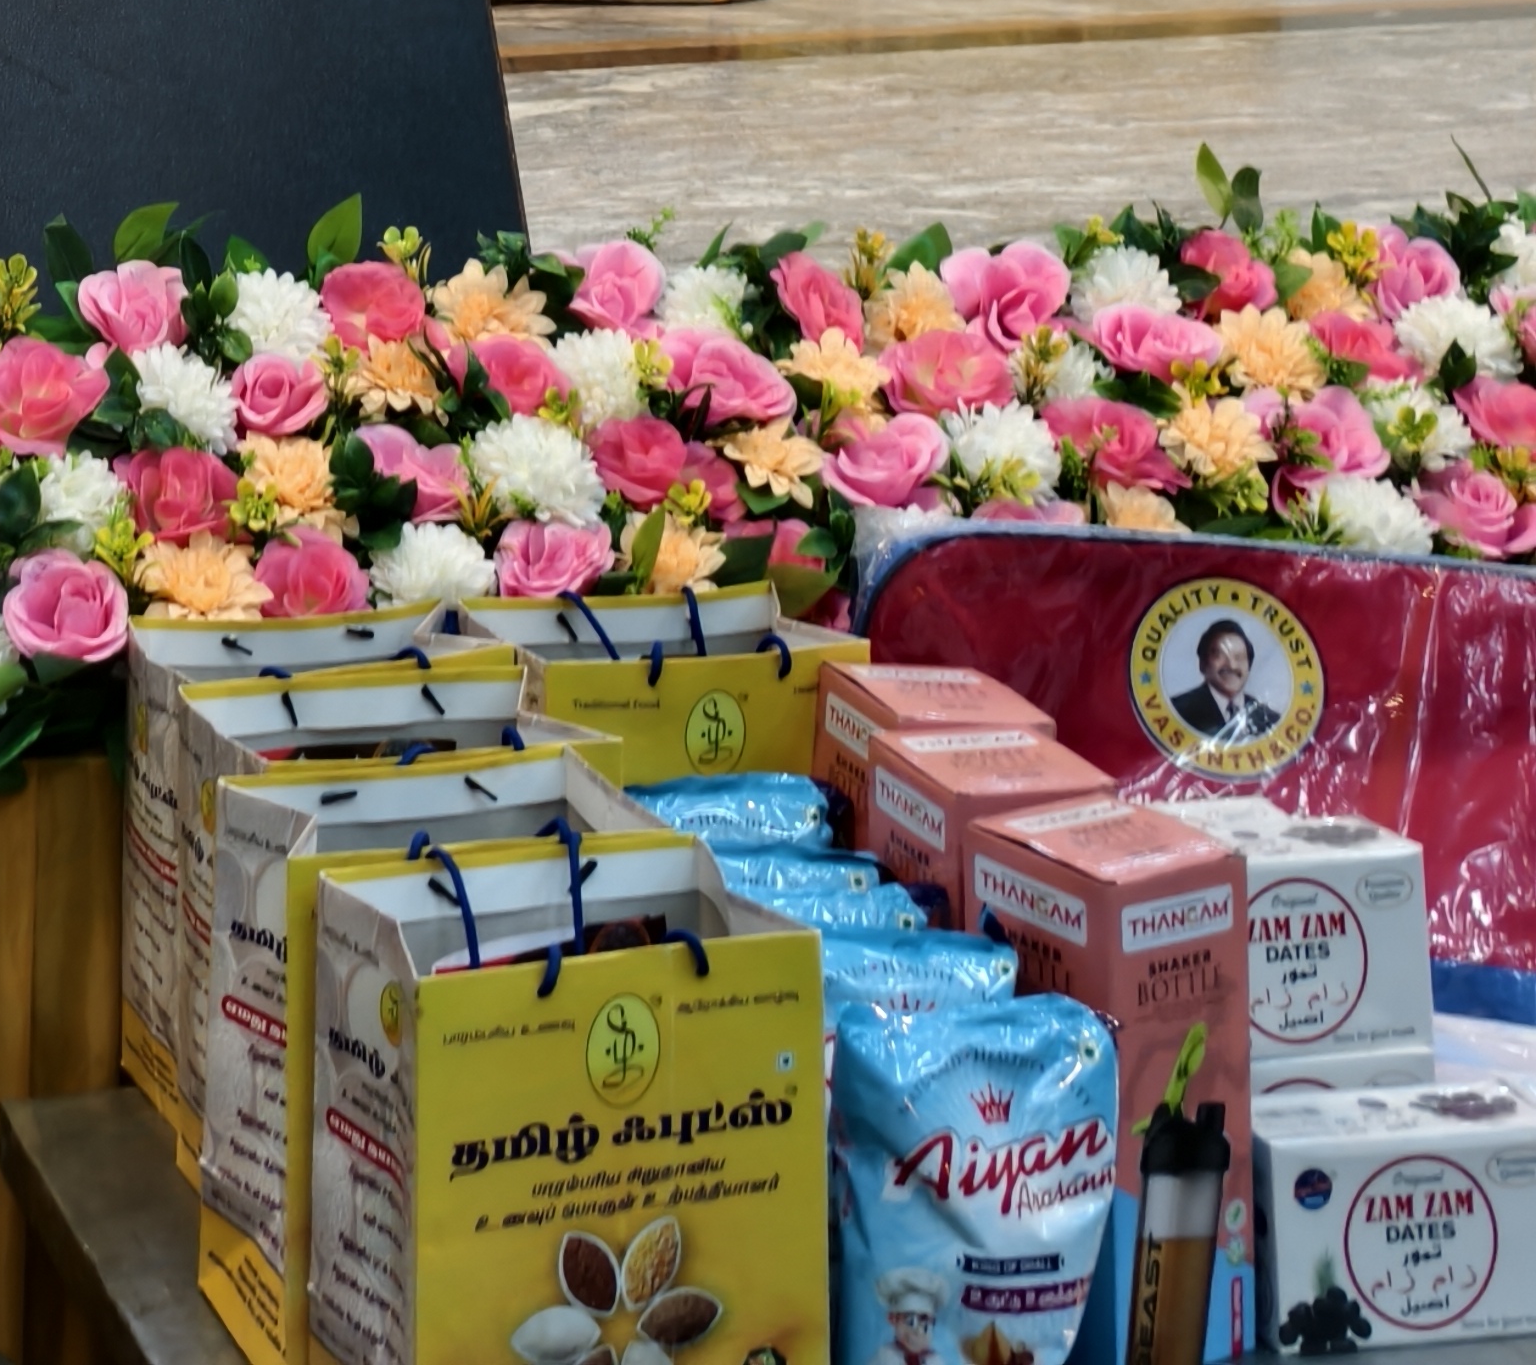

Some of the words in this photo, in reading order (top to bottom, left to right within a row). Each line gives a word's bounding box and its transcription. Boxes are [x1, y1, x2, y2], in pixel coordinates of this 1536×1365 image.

[1141, 585, 1221, 663] QUALITY
[1249, 592, 1313, 671] TRUST
[878, 780, 943, 839] THANGAM
[979, 869, 1083, 931] THANGAM
[1127, 899, 1229, 939] THANGAM
[1300, 910, 1347, 939] ZAM
[1007, 927, 1062, 963] HAKER
[1265, 940, 1331, 964] DATES
[449, 1112, 600, 1182] தமிழ்
[893, 1119, 1109, 1216] Aiyan
[1365, 1193, 1414, 1223] ZAM
[1424, 1187, 1474, 1218] ZAM
[1385, 1219, 1457, 1245] DATES
